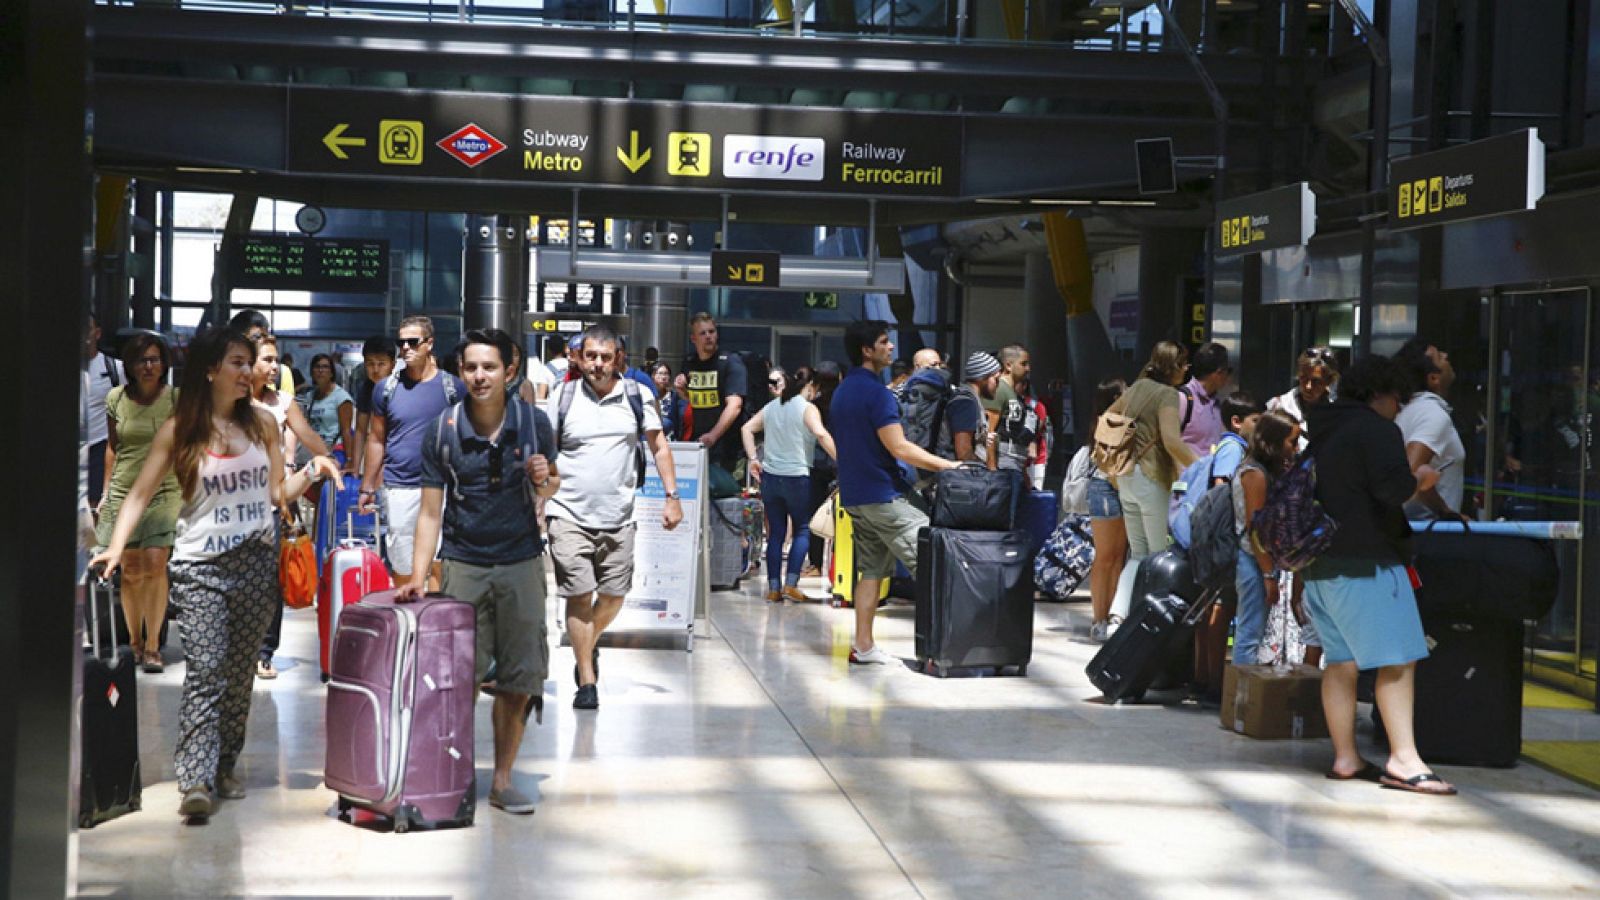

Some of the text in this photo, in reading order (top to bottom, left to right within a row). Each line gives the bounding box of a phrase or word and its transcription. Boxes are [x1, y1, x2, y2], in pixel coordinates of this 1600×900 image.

[456, 140, 486, 151] Metro
[523, 129, 588, 151] Subway
[523, 151, 582, 171] Metro
[733, 143, 814, 174] renfe
[842, 142, 906, 164] Railway
[842, 163, 943, 185] Ferrocarril
[203, 464, 269, 496] MUSIC
[214, 501, 266, 524] IS THE
